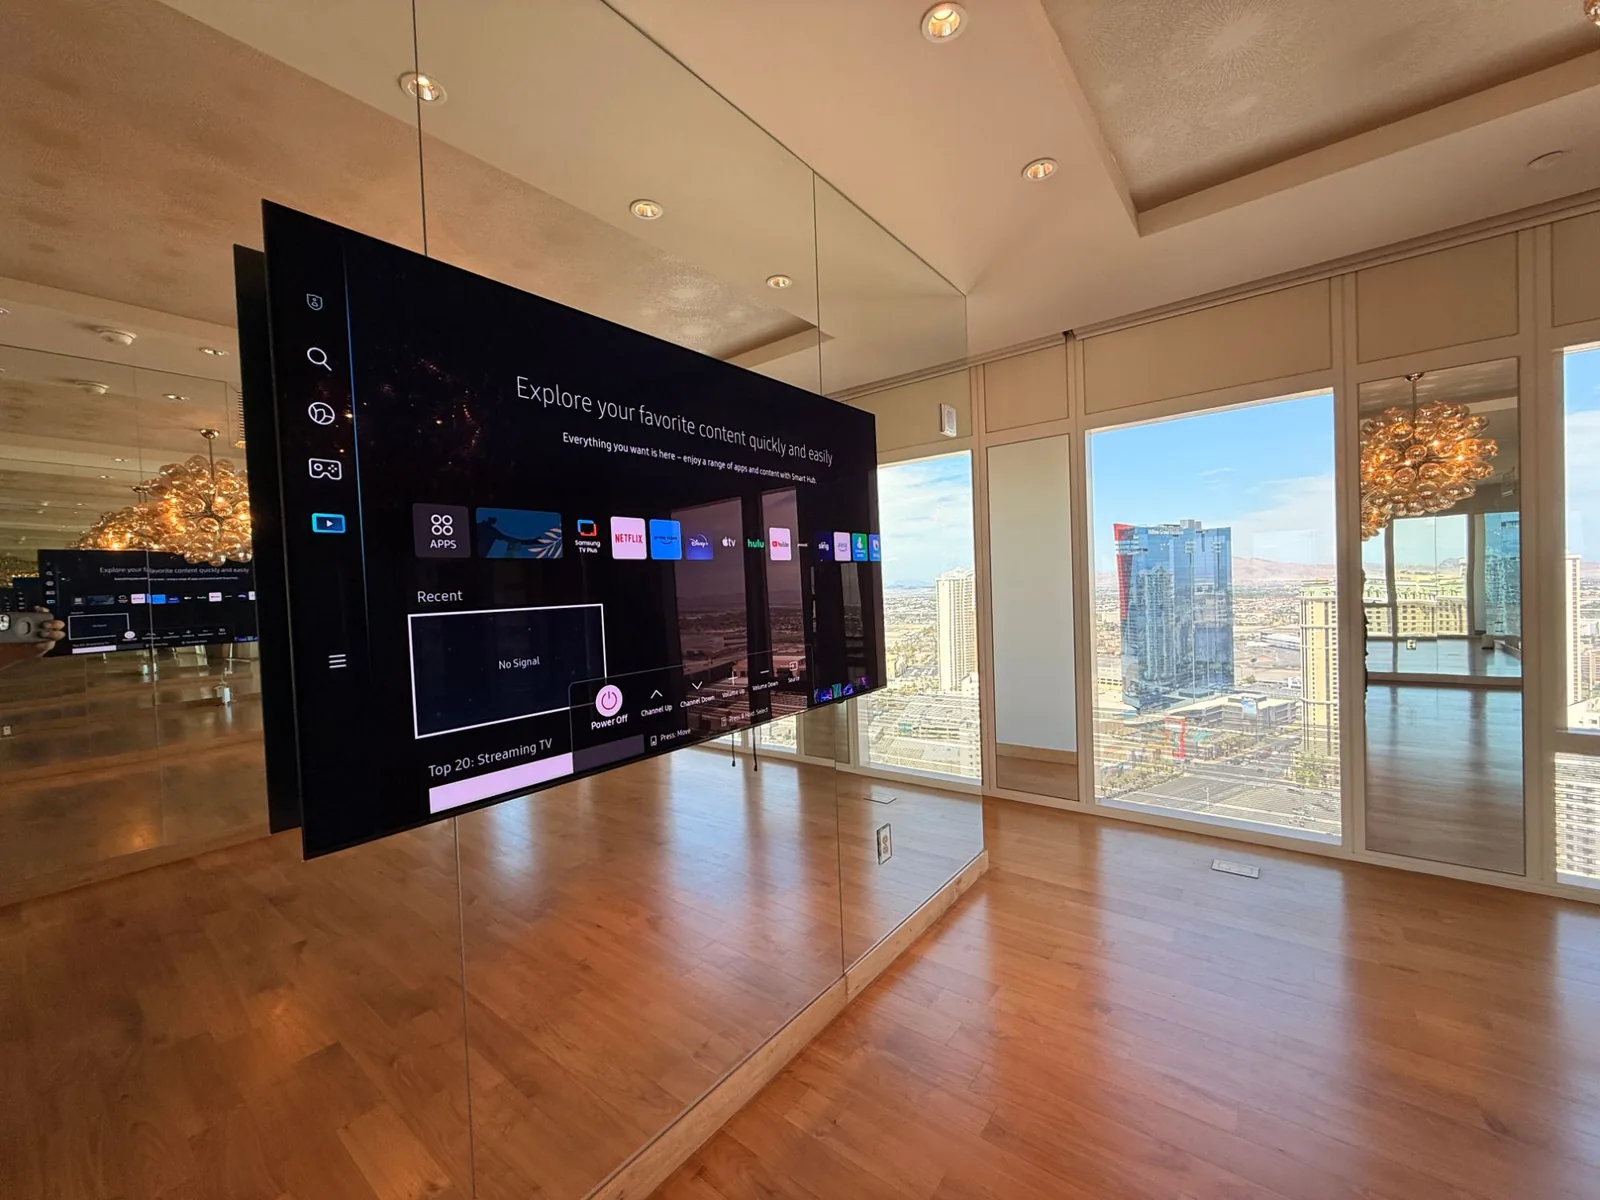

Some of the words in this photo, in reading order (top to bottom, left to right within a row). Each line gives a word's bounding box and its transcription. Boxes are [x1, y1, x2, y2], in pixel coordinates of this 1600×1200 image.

[516, 375, 592, 413] Explore
[597, 399, 636, 422] your
[638, 404, 696, 435] favorite
[699, 423, 747, 446] content
[749, 435, 787, 458] quickly
[788, 444, 806, 459] and
[808, 449, 833, 468] easily
[562, 432, 612, 453] Everything
[613, 442, 629, 454] you
[629, 445, 650, 457] want
[650, 447, 658, 458] is
[658, 448, 676, 461] here
[683, 454, 702, 467] enjoy
[702, 458, 707, 466] a
[707, 459, 726, 471] range
[726, 461, 733, 471] of
[733, 464, 748, 474] apps
[748, 466, 759, 475] and
[759, 467, 780, 479] content
[780, 469, 791, 480] with
[791, 472, 807, 483] Smart
[429, 538, 457, 550] APPS
[574, 539, 601, 548] Samsung
[614, 533, 644, 544] NETFLIX
[747, 538, 765, 549] hulu
[587, 546, 598, 554] Plus
[221, 566, 232, 574] and
[417, 590, 464, 603] Recent
[498, 660, 512, 670] No
[513, 655, 541, 669] Signal
[752, 682, 767, 692] Volume
[767, 680, 779, 689] Down
[721, 688, 739, 698] Volume
[680, 696, 700, 708] Channel
[701, 694, 716, 704] Down
[640, 705, 663, 717] Channel
[663, 703, 673, 714] Up
[591, 717, 615, 730] Power
[615, 713, 629, 726] Off
[660, 732, 676, 742] Press:
[677, 727, 692, 737] Move
[428, 764, 452, 778] Top
[455, 757, 475, 772] 20:
[477, 743, 537, 766] Streaming
[538, 738, 553, 750] TV
